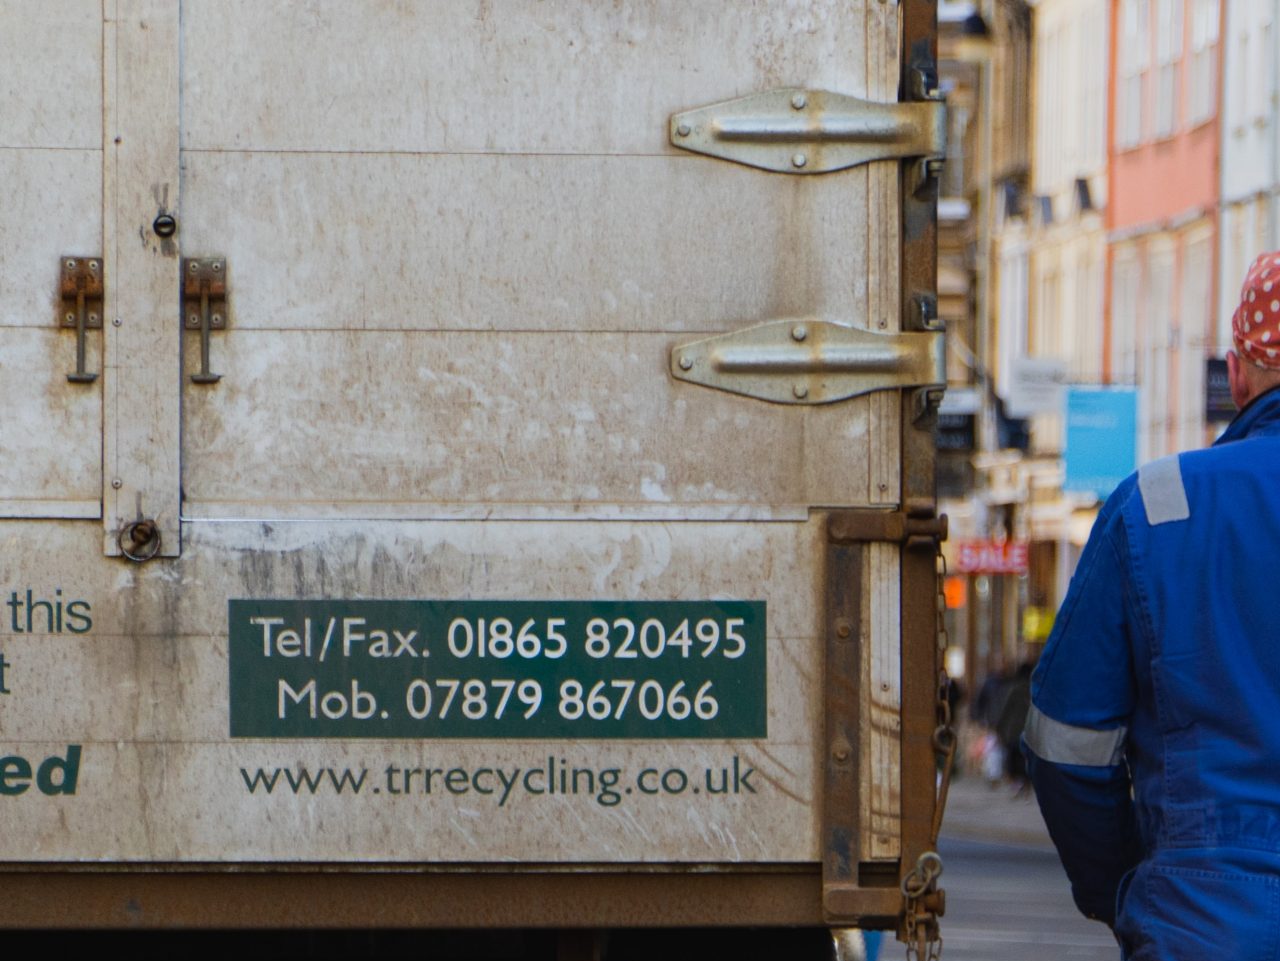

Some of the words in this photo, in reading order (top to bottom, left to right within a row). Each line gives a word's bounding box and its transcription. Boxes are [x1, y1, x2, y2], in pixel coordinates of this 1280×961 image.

[7, 589, 93, 634] this
[250, 617, 430, 662] Tel/Fax.
[447, 617, 567, 659] 01865
[584, 617, 747, 659] 820495
[278, 679, 389, 719] Mob.
[406, 679, 543, 720] 07879
[558, 679, 719, 720] 867066
[240, 756, 757, 807] www.trrecycling.co.uk
